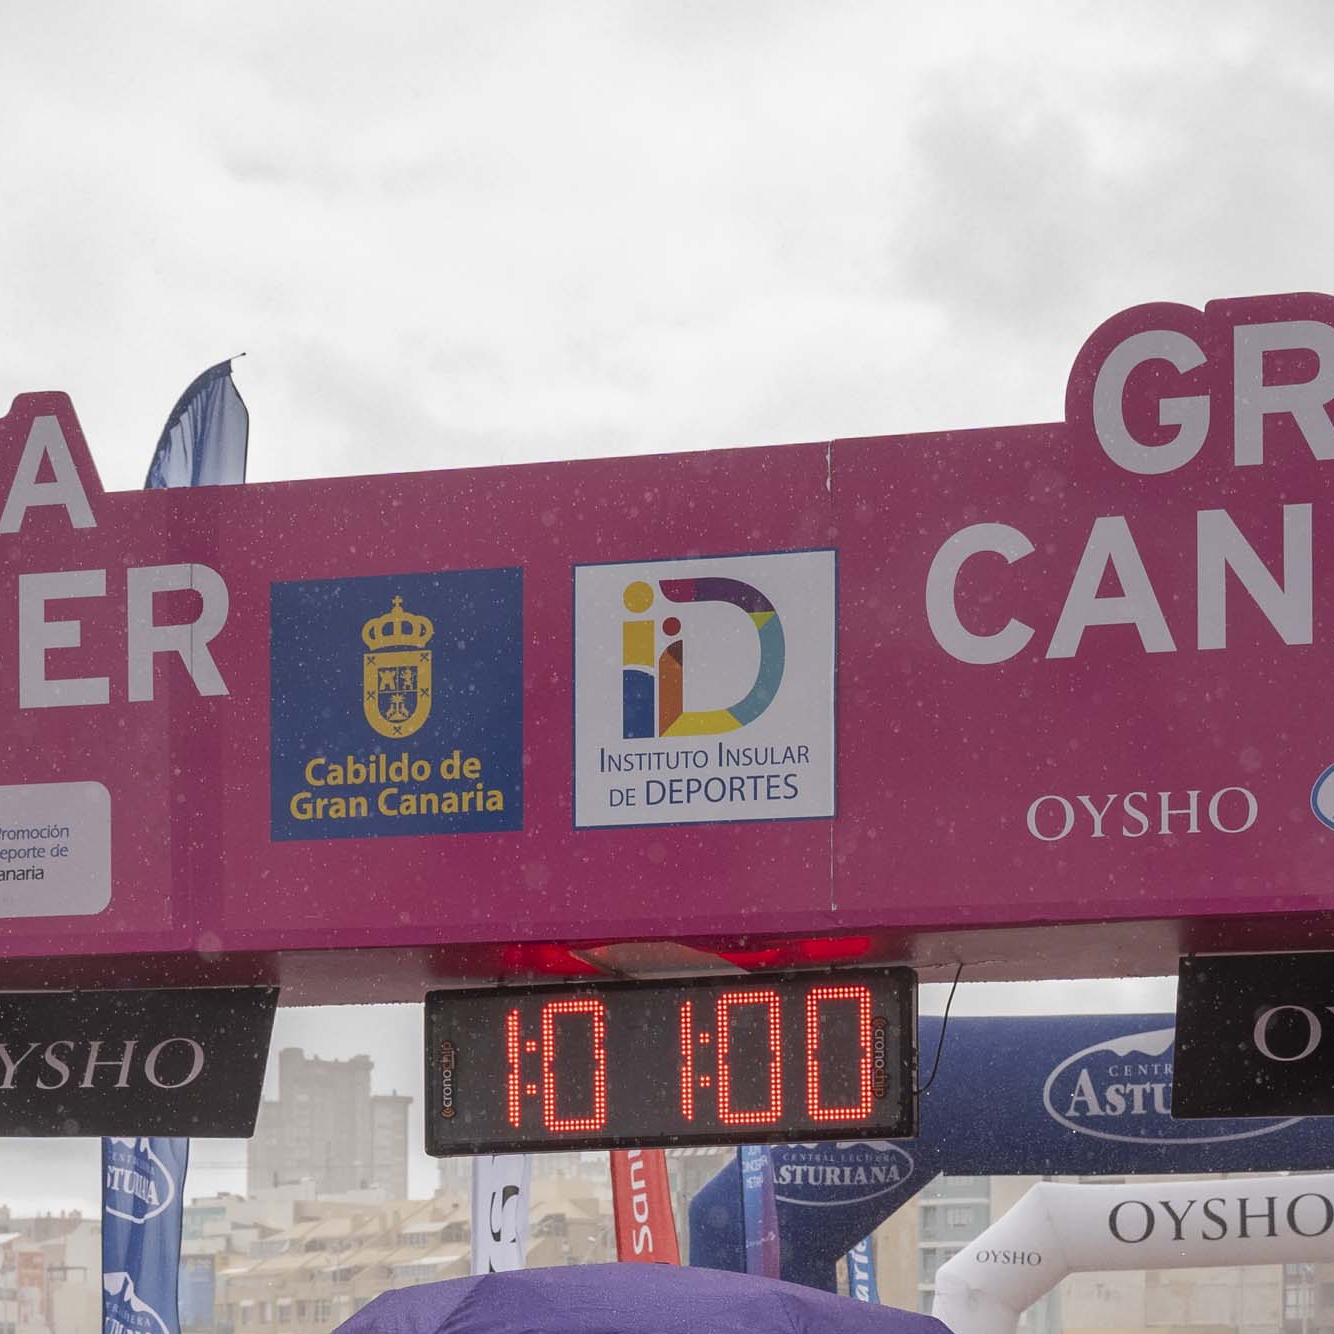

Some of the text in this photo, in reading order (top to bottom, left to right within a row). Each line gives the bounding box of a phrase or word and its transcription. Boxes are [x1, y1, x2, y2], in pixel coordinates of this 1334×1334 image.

[305, 750, 481, 788] Cabildo de
[600, 742, 809, 773] INSTITUTO INSULAR
[290, 784, 504, 821] Gran Canaria
[609, 773, 798, 807] DE DEPORTES
[1026, 786, 1258, 842] OYSHO
[49, 843, 68, 859] de
[441, 1041, 455, 1106] cronochip
[872, 1028, 886, 1097] cronochip
[1109, 1192, 1334, 1245] OYSHO
[976, 1251, 1042, 1266] OYSHO
